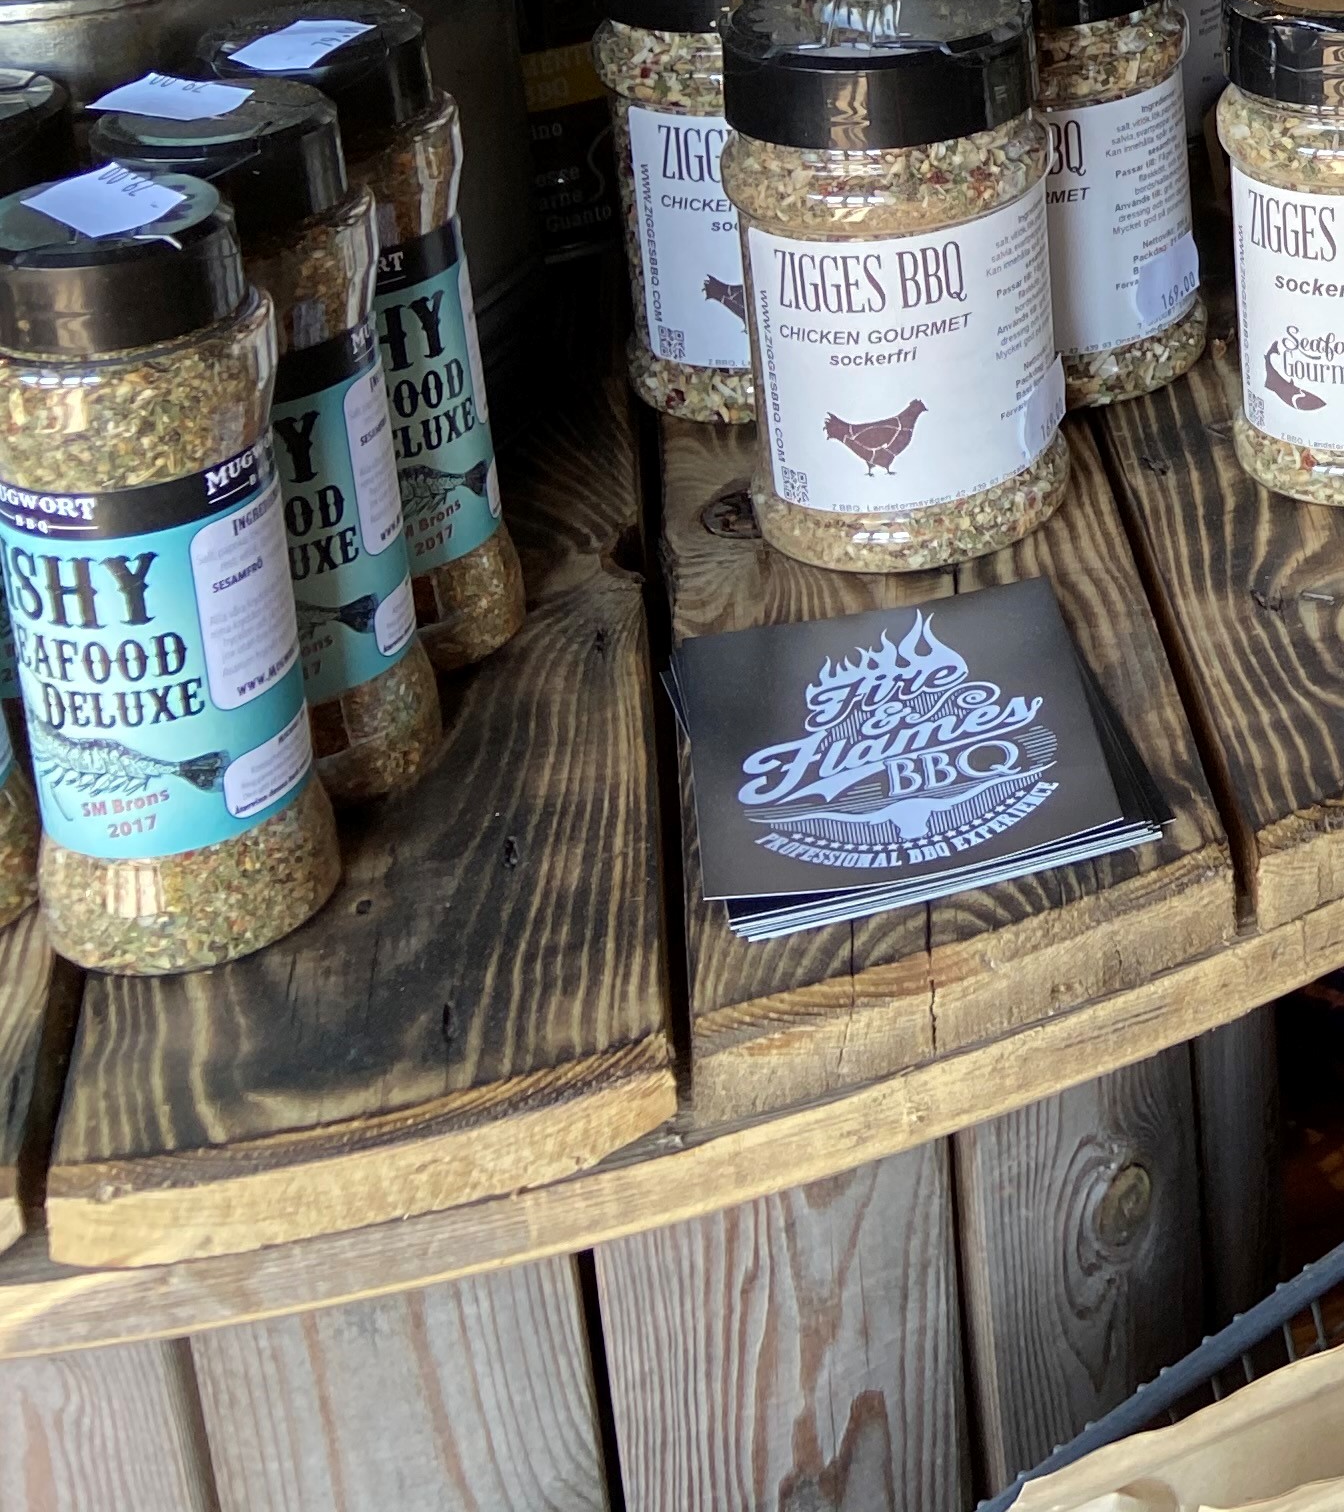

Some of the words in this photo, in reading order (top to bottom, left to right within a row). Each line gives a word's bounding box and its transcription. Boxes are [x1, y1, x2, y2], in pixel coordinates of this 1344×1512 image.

[1114, 194, 1151, 213] Används
[1112, 220, 1141, 236] Mycket
[1248, 189, 1337, 262] ZIGGES
[773, 248, 887, 314] ZIGGES
[895, 240, 968, 310] BBQ
[1161, 271, 1197, 312] 169.00
[779, 323, 861, 346] CHICKEN
[867, 311, 973, 345] GOURMET
[828, 346, 918, 368] sockerfri
[413, 522, 454, 557] 2017
[40, 677, 206, 731] DELUXE
[806, 664, 969, 732] Fire
[862, 702, 908, 736] &
[738, 696, 1044, 806] Flames
[883, 740, 1024, 797] BBQ
[81, 800, 108, 818] SM
[112, 789, 170, 815] Brons
[107, 813, 158, 839] 2017
[754, 831, 901, 869] PROFESSIONAL
[907, 841, 952, 866] BBQ
[954, 781, 1060, 854] EXPERIENCE
